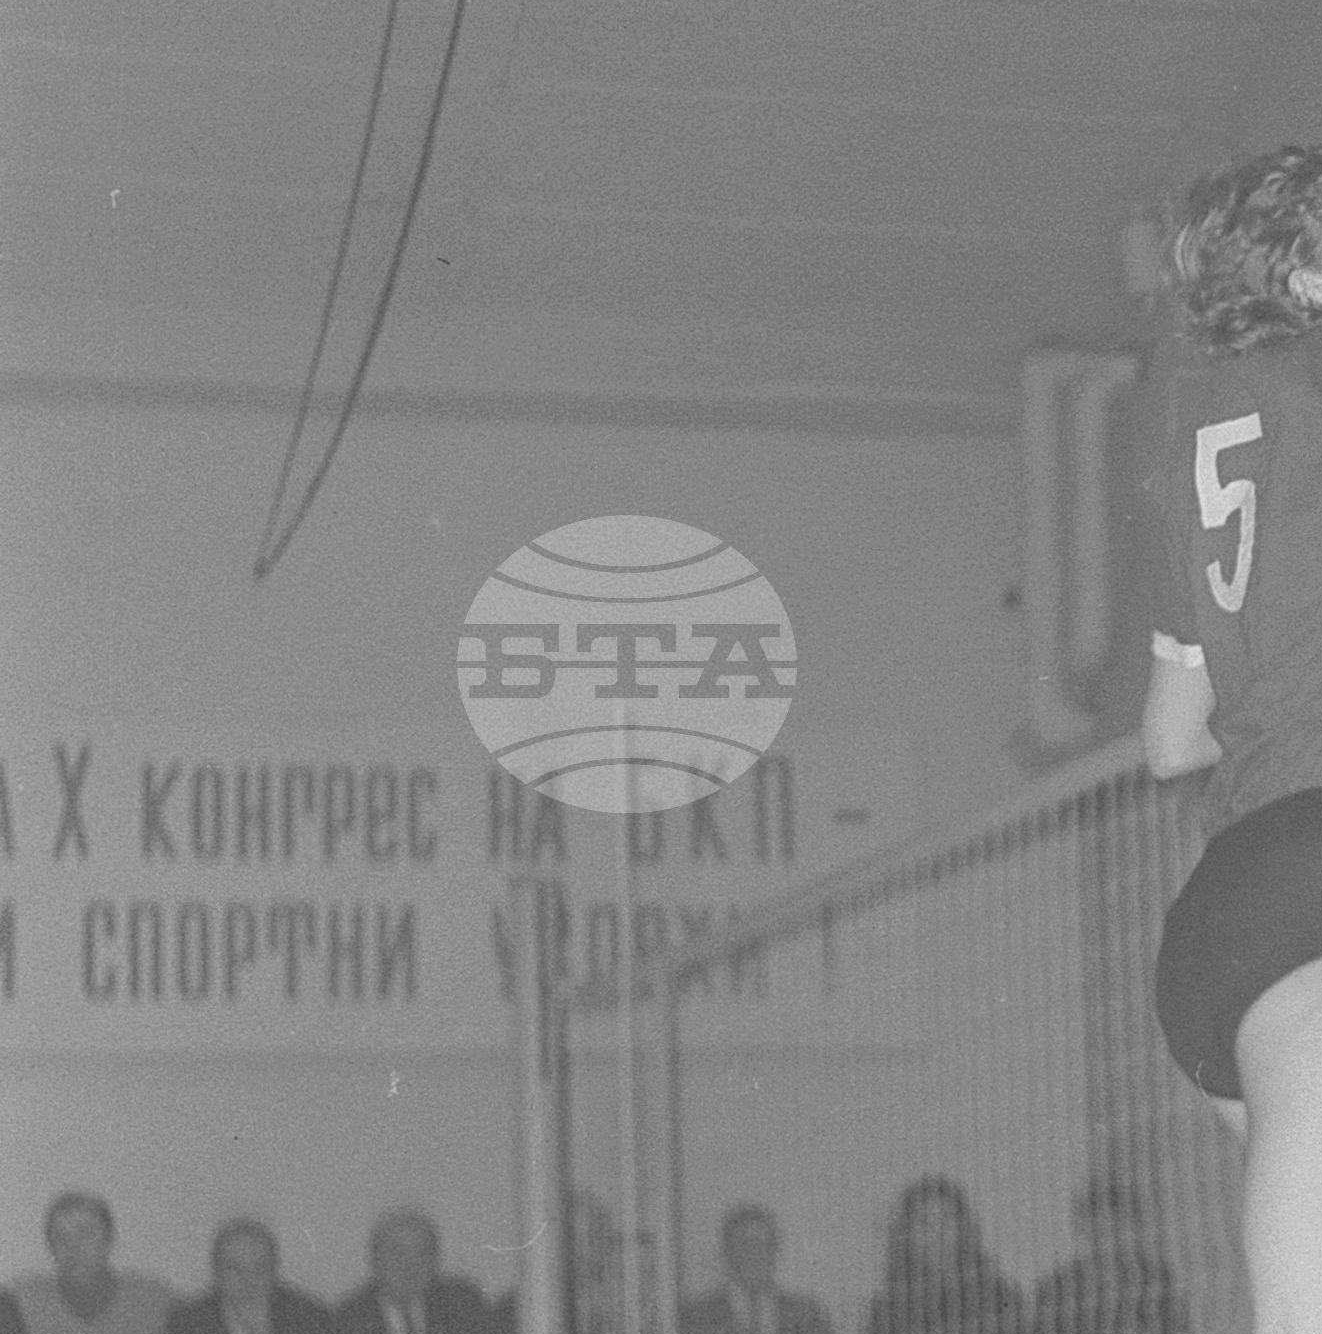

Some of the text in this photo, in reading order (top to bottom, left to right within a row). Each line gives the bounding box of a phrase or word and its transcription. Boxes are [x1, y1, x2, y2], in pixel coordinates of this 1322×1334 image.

[1195, 411, 1263, 613] 5
[139, 757, 439, 864] КОНГРЕС
[80, 897, 418, 1005] СПОРТНИ
